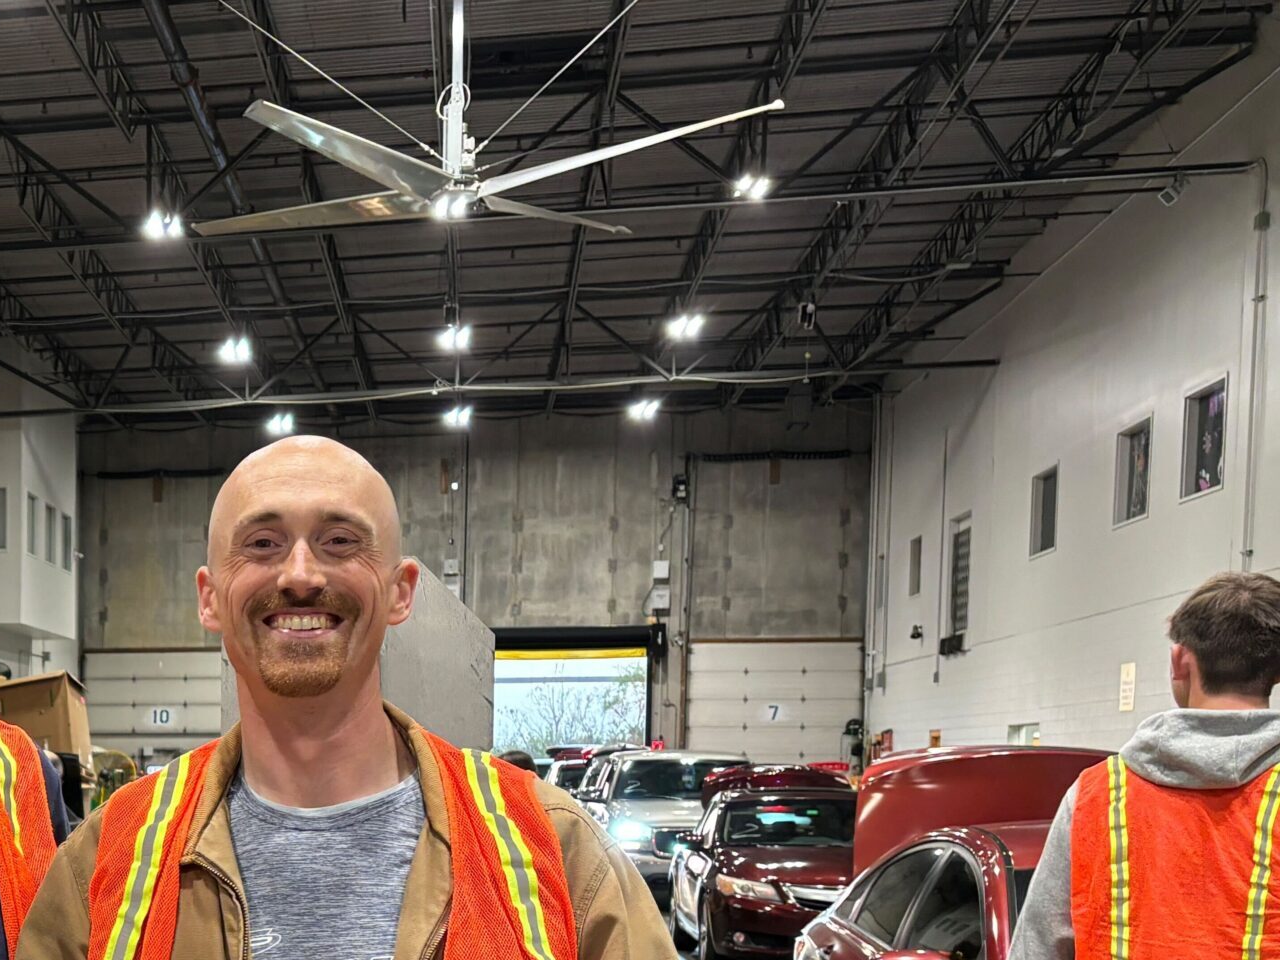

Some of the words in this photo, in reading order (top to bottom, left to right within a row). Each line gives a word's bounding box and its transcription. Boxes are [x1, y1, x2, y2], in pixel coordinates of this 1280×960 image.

[153, 709, 169, 724] 10
[768, 705, 779, 721] 7
[731, 823, 761, 839] 2
